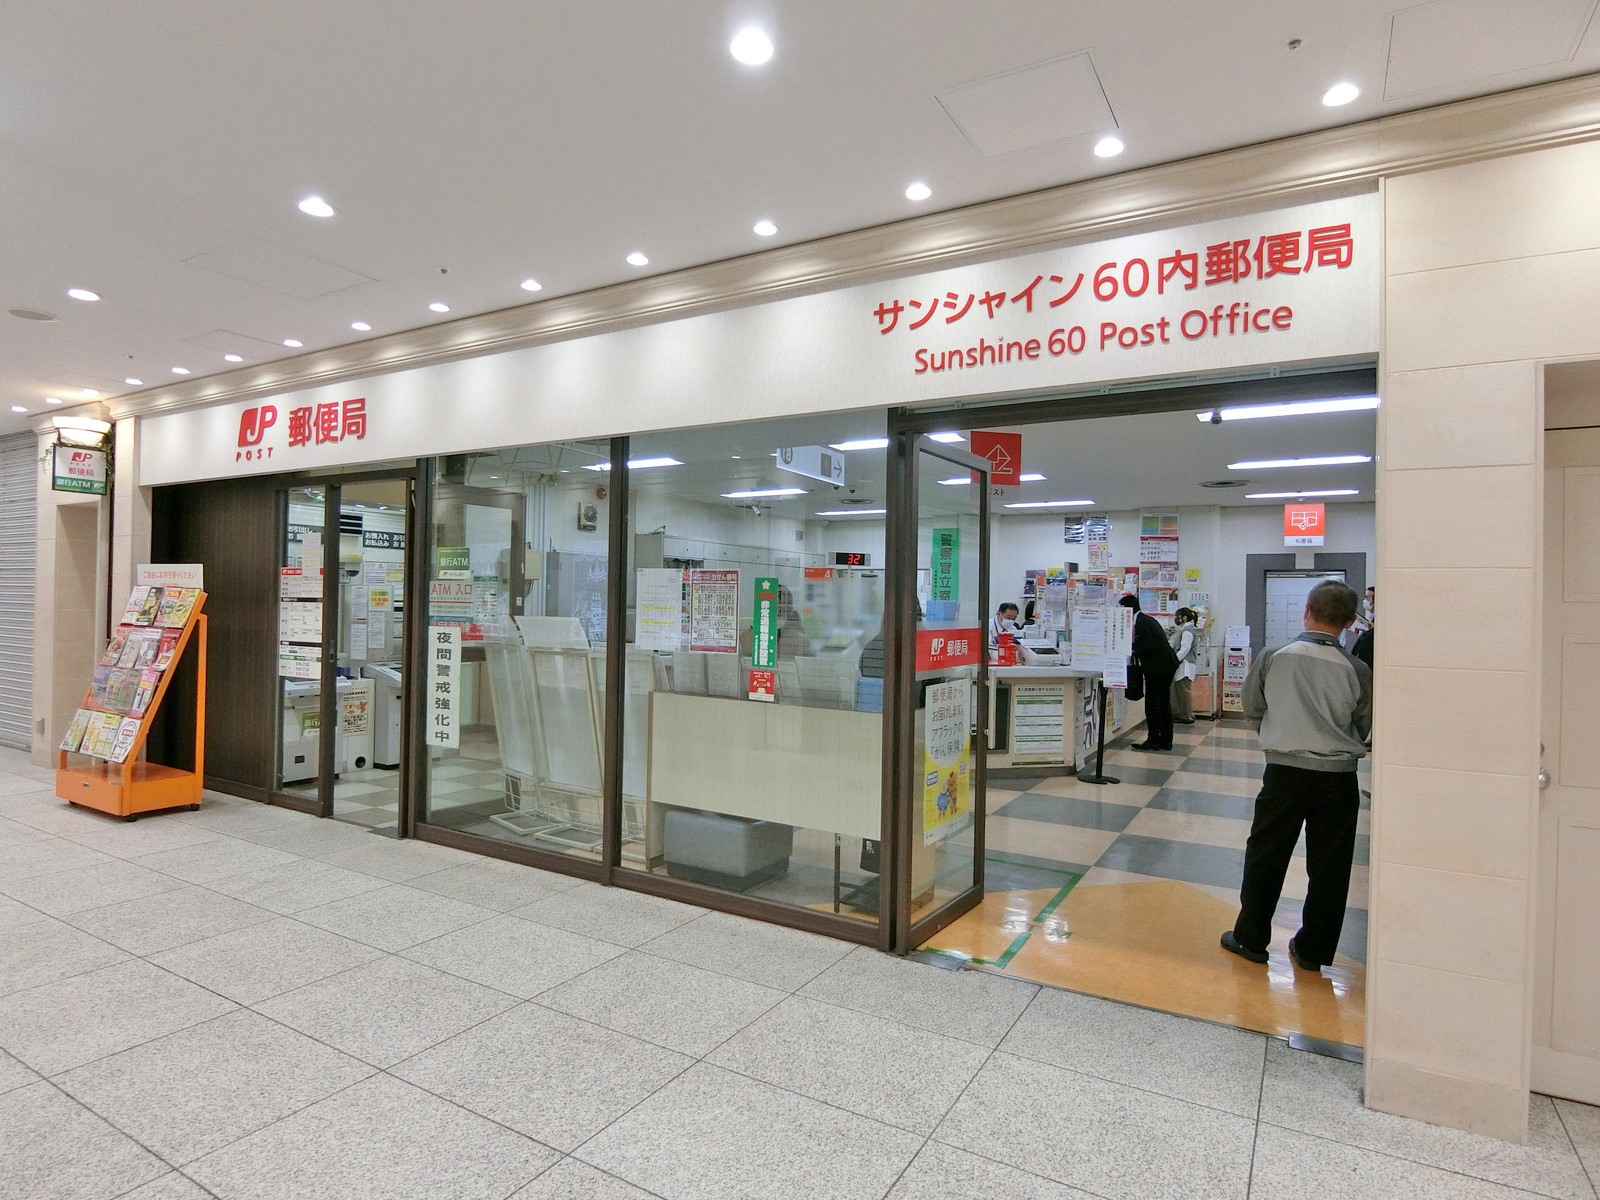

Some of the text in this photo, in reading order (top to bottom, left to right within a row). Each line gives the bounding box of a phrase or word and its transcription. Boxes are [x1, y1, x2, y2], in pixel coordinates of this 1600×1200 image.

[873, 222, 1353, 335] サンシャイン60内郵便局
[914, 302, 1293, 374] Sunshine 60 Post Office
[288, 397, 367, 447] 郵便局
[235, 446, 273, 461] POST
[68, 467, 95, 477] 郵便局
[57, 478, 91, 489] 銀行ATM
[364, 532, 390, 541] お預入れ
[364, 539, 390, 548] お払込み
[440, 557, 469, 567] 銀行ATM
[847, 553, 861, 565] 32
[824, 570, 832, 578] 4
[431, 584, 473, 596] ATM 入口
[946, 639, 968, 659] 郵便局
[434, 631, 454, 743] 夜間警戒強化中
[932, 684, 964, 704] 郵便局から
[931, 721, 963, 742] アフラックの
